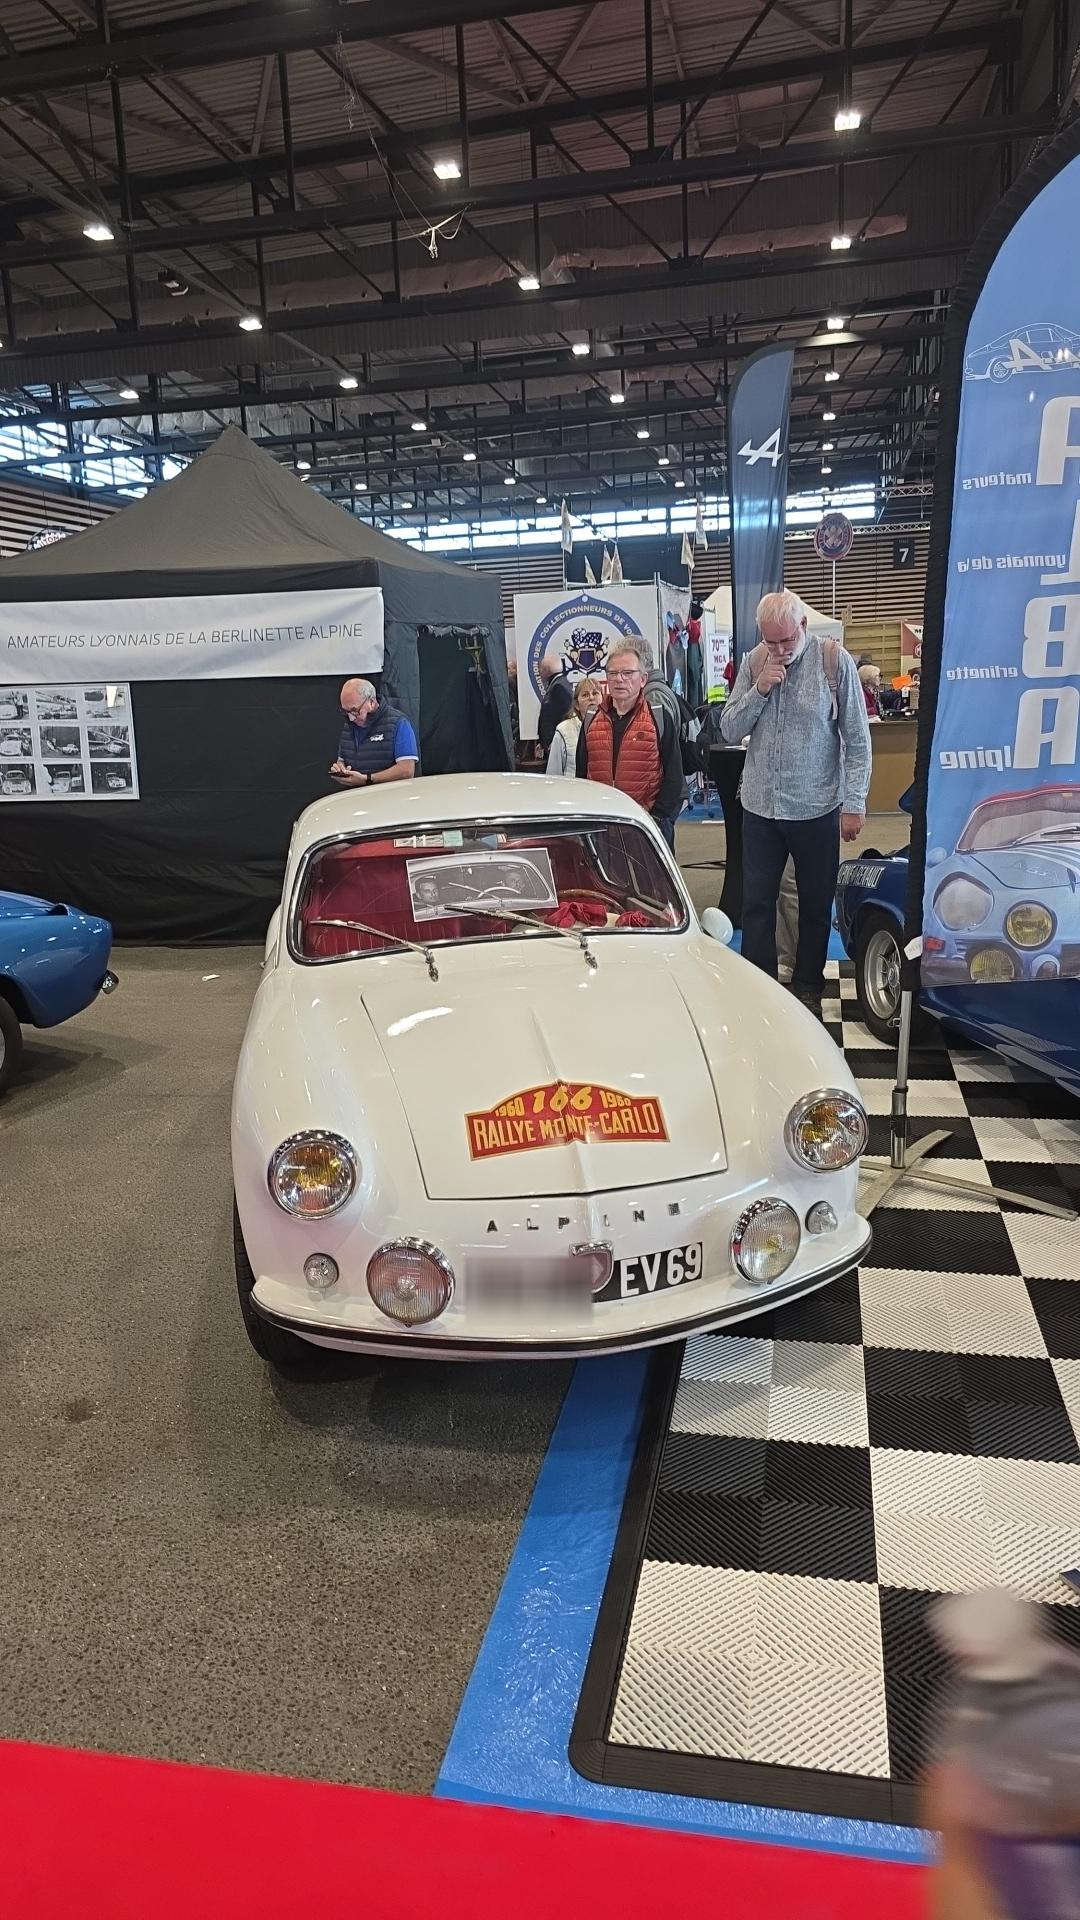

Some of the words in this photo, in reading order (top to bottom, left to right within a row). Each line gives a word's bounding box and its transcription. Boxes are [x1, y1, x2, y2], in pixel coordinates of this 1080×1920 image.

[899, 548, 909, 563] 7
[7, 635, 86, 649] AMATEURS
[90, 632, 162, 648] LYONNAIS
[165, 632, 185, 645] DE
[188, 631, 207, 644] LA
[211, 626, 305, 643] BERLINETTE
[309, 623, 363, 639] ALPINE
[534, 641, 543, 658] DES
[540, 604, 613, 639] COLLECTIONNEURS
[614, 614, 625, 625] DE
[623, 624, 633, 635] VO
[495, 1097, 525, 1117] 1960
[532, 1085, 593, 1114] 166
[473, 1119, 537, 1151] RALLYE
[539, 1102, 660, 1141] MONTE-CARLO
[487, 1202, 681, 1233] ALPINE
